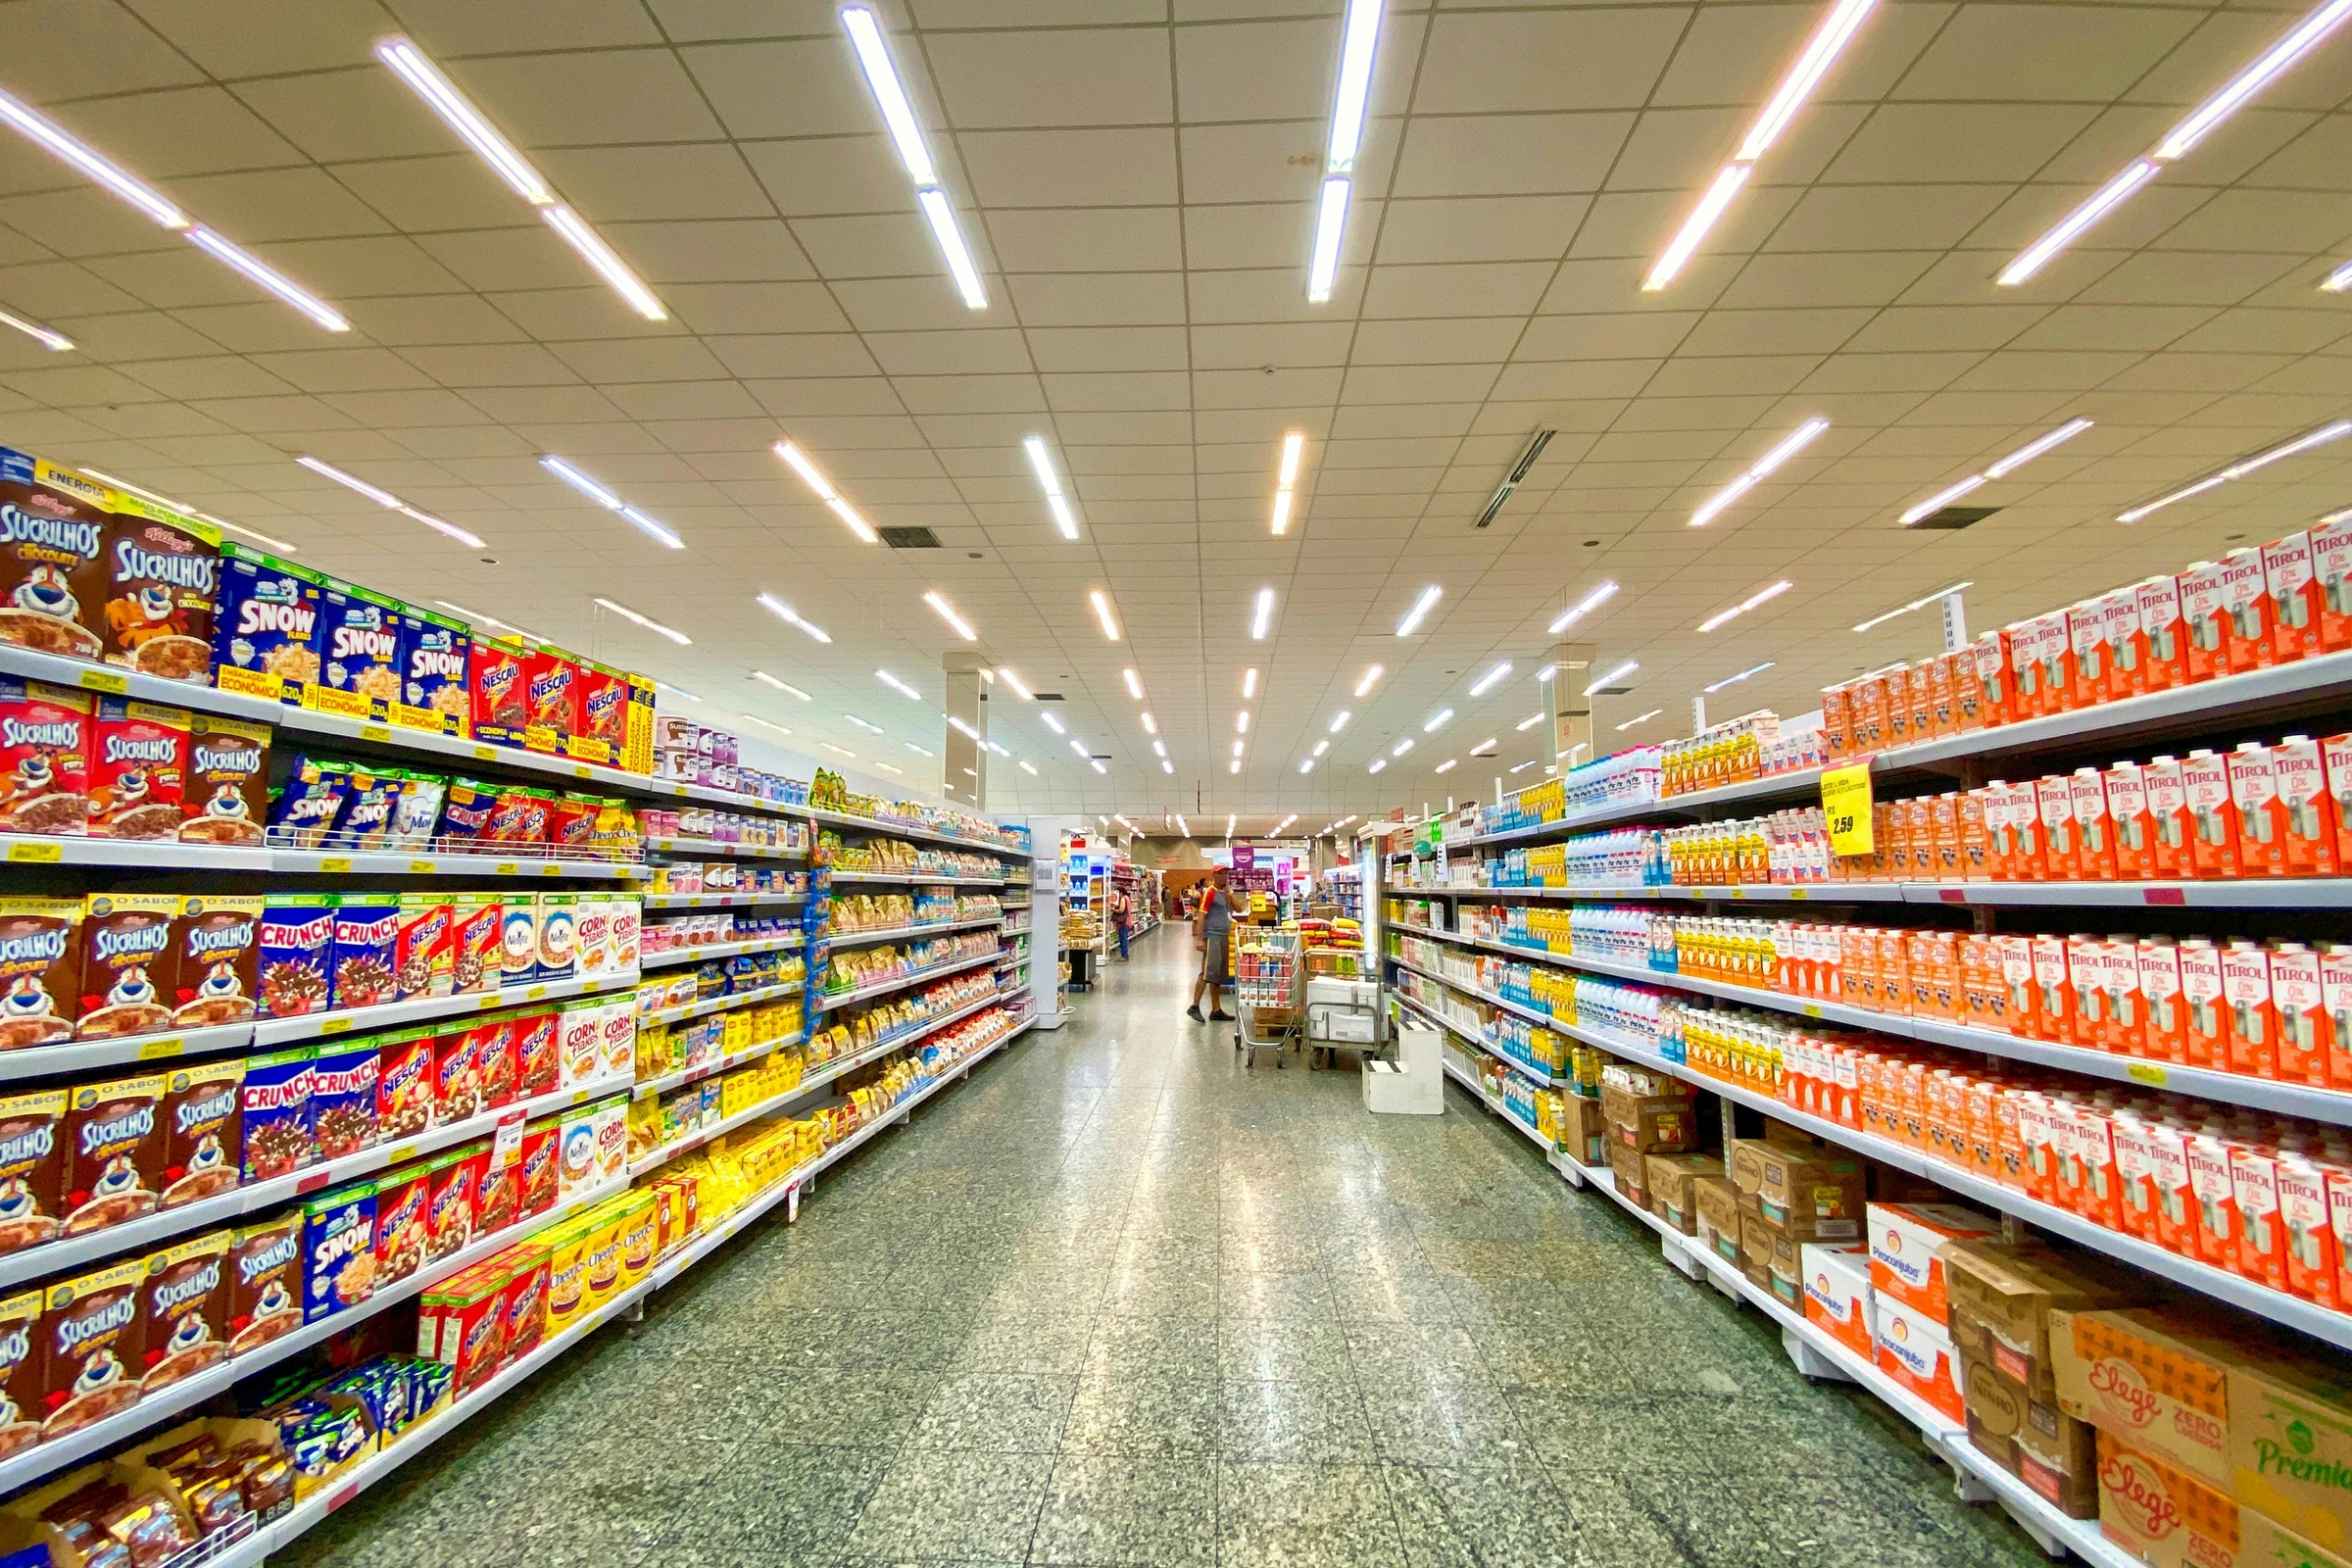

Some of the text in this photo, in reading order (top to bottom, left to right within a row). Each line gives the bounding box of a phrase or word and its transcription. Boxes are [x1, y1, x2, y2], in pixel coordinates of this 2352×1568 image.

[48, 469, 106, 499] ENERGIA
[1, 504, 101, 560] SUCRILHOS
[116, 540, 215, 595] SUCRILHOS
[2266, 549, 2310, 570] TIROL
[2328, 554, 2346, 566] 0%
[2221, 564, 2261, 585] TIROL
[2280, 569, 2296, 581] 0%
[2181, 578, 2221, 598] TIROL
[2235, 583, 2250, 595] 0%
[2140, 592, 2176, 610] TIROL
[237, 600, 316, 634] SNOW
[2072, 614, 2102, 632] TIROL
[2104, 604, 2137, 621] TIROL
[332, 626, 397, 658] SNOW
[2012, 635, 2036, 651] TIROL
[2037, 626, 2065, 642] TIROL
[411, 650, 465, 678] SNOW
[1976, 646, 2000, 661] TIROL
[222, 667, 267, 684] EMBALAGEM
[481, 662, 519, 693] NESCAU
[530, 669, 571, 701] NESCAU
[220, 676, 280, 700] ECONÔMICA
[306, 691, 316, 702] 20
[320, 688, 358, 703] EMBALAGEM
[320, 699, 368, 717] ECONÔMICA
[401, 706, 433, 718] EMBALAGEM
[586, 687, 622, 716] NESCAU
[3, 717, 79, 750] SUCRILHOS
[225, 721, 270, 734] SABOR
[400, 714, 442, 732] ECONÔMICA
[106, 735, 177, 764] SUCRILHOS
[195, 745, 262, 774] SUCRILHOS
[2230, 764, 2274, 780] TIROL
[2276, 759, 2318, 775] TIROL
[2108, 781, 2142, 795] TIROL
[2146, 776, 2181, 791] TIROL
[2184, 771, 2225, 786] TIROL
[2245, 782, 2261, 794] 0%
[2291, 775, 2308, 789] 0%
[1984, 797, 2008, 808] TIROL
[2009, 794, 2034, 807] TIROL
[2040, 790, 2069, 803] TIROL
[2073, 786, 2102, 799] TIROL
[2198, 787, 2213, 798] 0%
[286, 797, 342, 821] SNOW
[491, 805, 523, 832] NESCAU
[562, 811, 596, 839] NESCAU
[1834, 815, 1853, 835] 2,59
[25, 901, 82, 909] SABOR
[132, 897, 179, 906] SABOR
[261, 916, 333, 947] CRUNCH
[336, 916, 399, 946] CRUNCH
[409, 913, 448, 950] NESCAU
[465, 910, 498, 945] NESCAU
[579, 914, 606, 938] CORN
[612, 913, 637, 935] CORN
[617, 923, 639, 945] flakes
[0, 927, 69, 962] UCRILHOS
[95, 921, 171, 961] SUCRILHOS
[189, 921, 255, 957] SUCRILHOS
[305, 938, 328, 952] CEREAL
[583, 927, 609, 948] flakes
[2003, 949, 2028, 962] TIROL
[2034, 951, 2062, 965] TIROL
[2070, 953, 2100, 967] TIROL
[2101, 956, 2135, 970] TIROL
[2138, 958, 2176, 973] TIROL
[2182, 960, 2219, 976] TIROL
[2224, 963, 2266, 979] TIROL
[2273, 966, 2318, 983] TIROL
[2194, 978, 2209, 989] 0%
[2238, 982, 2253, 994] 0%
[2287, 985, 2304, 998] 0%
[566, 1020, 596, 1048] CORN
[604, 1013, 630, 1039] CORN
[610, 1026, 633, 1048] flakes
[520, 1021, 553, 1060] NESCAU
[572, 1035, 598, 1057] flakes
[206, 1061, 245, 1074] SABOR
[441, 1039, 478, 1085] NESCAU
[315, 1058, 379, 1094] CRUNCH
[383, 1048, 429, 1100] NESCAU
[102, 1078, 165, 1094] O SABOR
[245, 1069, 316, 1108] CRUNCH
[9, 1094, 65, 1108] SABOR
[176, 1087, 237, 1134] SUCRILHOS
[2019, 1108, 2048, 1127] TIROL
[2049, 1117, 2077, 1134] TIROL
[81, 1104, 155, 1155] SUCRILHOS
[599, 1117, 623, 1146] CORN
[2077, 1126, 2107, 1145] TIROL
[604, 1131, 625, 1155] flakes
[2114, 1136, 2148, 1154] TIROL
[523, 1135, 557, 1182] NESCAU
[2148, 1145, 2184, 1166] TIROL
[2189, 1155, 2228, 1176] TIROL
[2233, 1166, 2273, 1190] TIROL
[430, 1168, 469, 1222] NESCAU
[2280, 1179, 2324, 1203] TIROL
[379, 1186, 425, 1246] NESCAU
[172, 1233, 229, 1257] O SABOR
[313, 1219, 373, 1275] SNOW
[624, 1223, 655, 1249] Cheerios
[239, 1234, 297, 1285] SUCRILHOS
[588, 1242, 621, 1268] Cheerios
[1873, 1246, 1919, 1278] Piracanjuba
[77, 1262, 144, 1289] O SABOR
[550, 1262, 586, 1290] Cheerios
[154, 1260, 220, 1317] SUCRILHOS
[510, 1271, 546, 1323] NESCAU
[1805, 1283, 1844, 1315] Piracanjuba
[58, 1293, 135, 1355] SUCRILHOS
[466, 1294, 505, 1353] NESCAU
